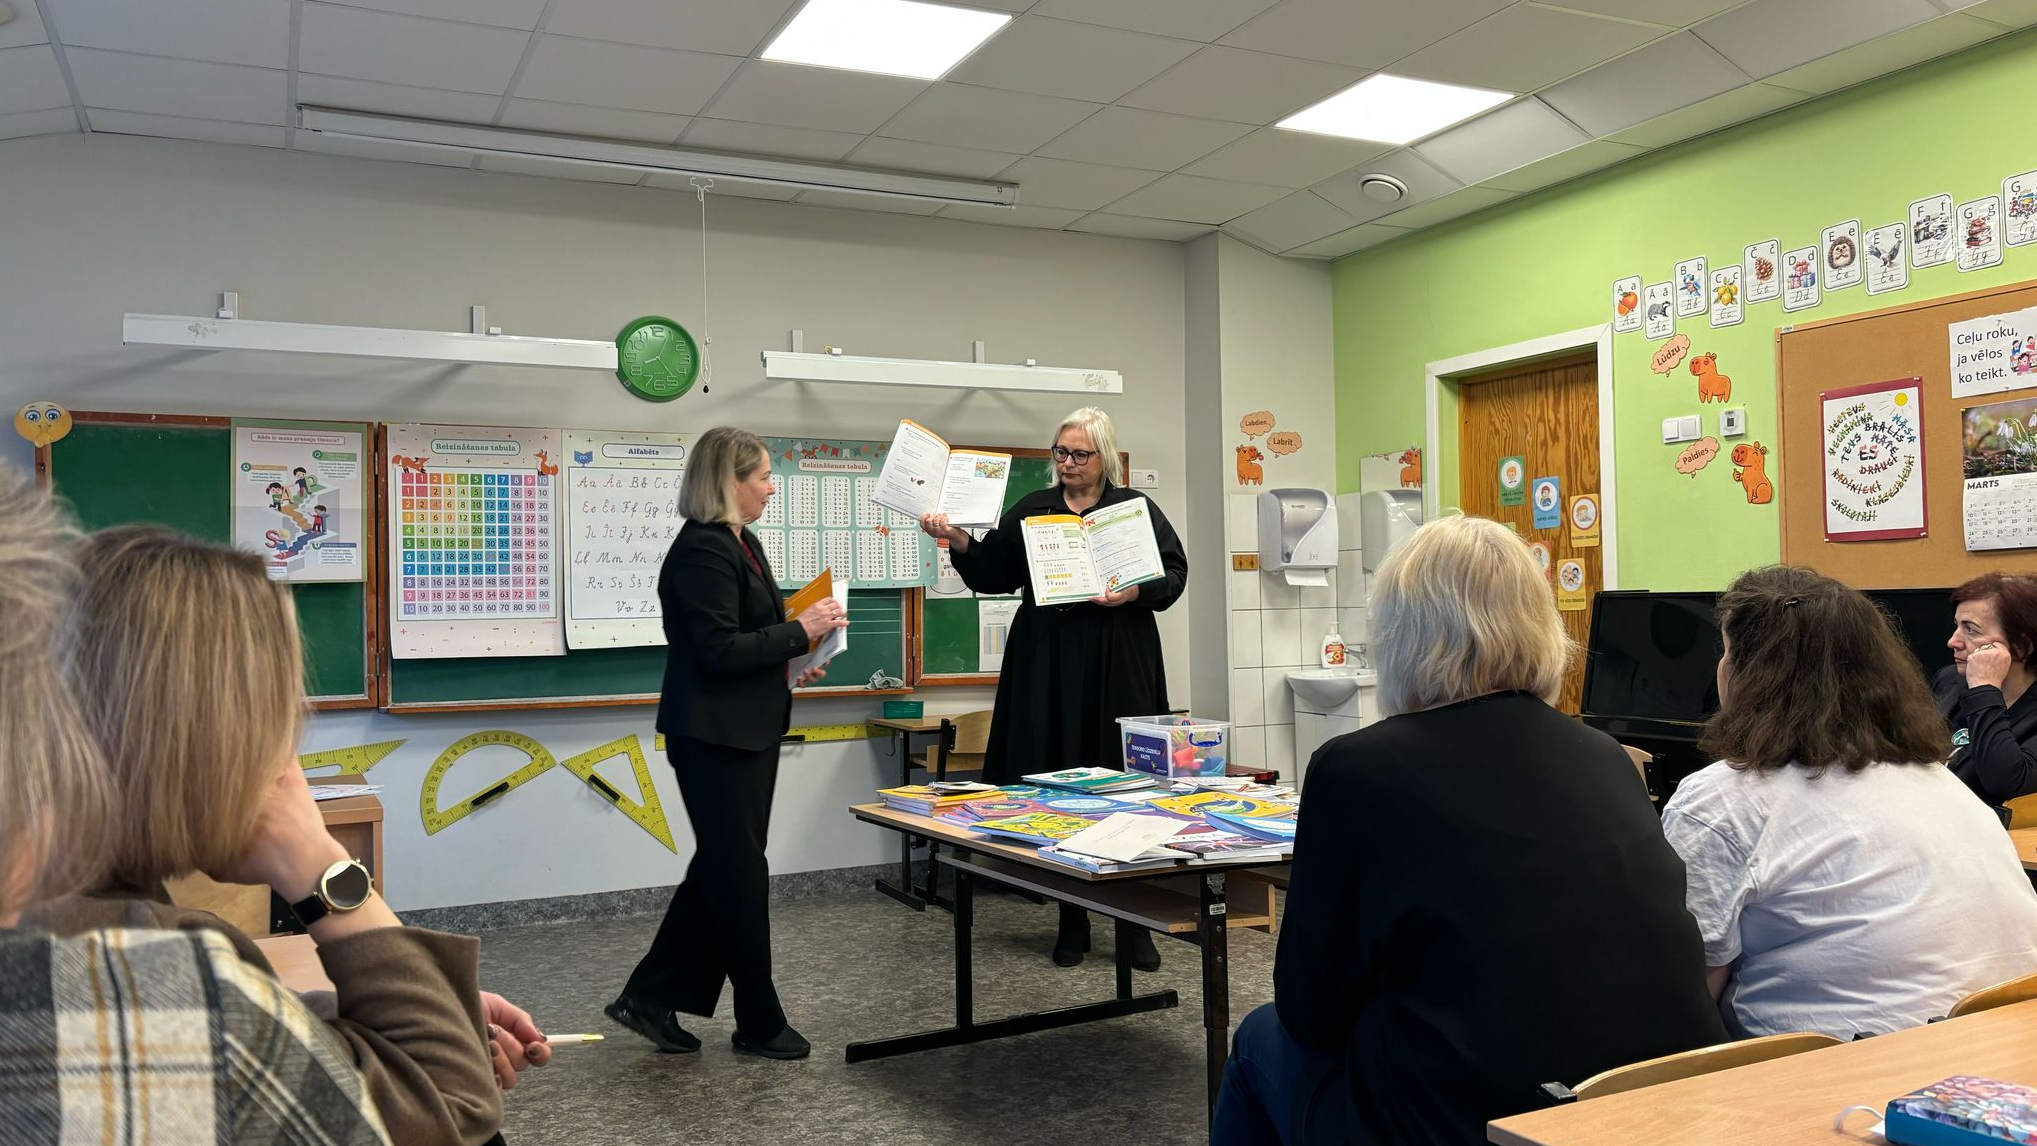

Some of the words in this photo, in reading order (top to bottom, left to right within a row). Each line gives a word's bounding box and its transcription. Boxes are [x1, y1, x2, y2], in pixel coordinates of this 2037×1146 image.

[1917, 206, 1924, 217] F
[1940, 200, 1945, 211] f
[1964, 207, 1973, 219] G
[1988, 204, 1996, 216] g
[1829, 231, 1835, 242] E
[1849, 228, 1855, 236] e
[1894, 229, 1901, 239] ē
[1750, 246, 1757, 259] Č
[1769, 243, 1775, 254] č
[1788, 255, 1797, 266] D
[1808, 250, 1814, 261] d
[1680, 265, 1687, 275] B
[1697, 261, 1703, 271] b
[1715, 273, 1722, 283] C
[1733, 272, 1738, 280] c
[1617, 285, 1623, 294] A
[1631, 283, 1636, 291] a
[1649, 289, 1656, 299] Ā
[1662, 288, 1668, 297] ā
[638, 331, 648, 340] 11
[650, 326, 664, 337] 12
[1957, 331, 1982, 345] Ceļu
[1986, 326, 2018, 340] roku,
[629, 340, 646, 350] 10
[675, 340, 686, 351] 2
[625, 352, 636, 363] 9
[680, 354, 691, 365] 3
[1656, 345, 1681, 366] Lūdzu
[1956, 353, 1967, 367] ja
[1970, 349, 2003, 362] vēlos
[631, 365, 642, 376] 8
[1958, 373, 1972, 384] ko
[1976, 367, 2007, 381] teikt.
[643, 374, 654, 387] 7
[654, 379, 665, 391] 6
[666, 376, 678, 387] 5
[490, 444, 516, 452] tabula
[628, 448, 660, 456] Alfabēts
[1682, 447, 1709, 465] Paldies
[420, 474, 424, 482] 1
[460, 475, 466, 483] 4
[473, 475, 479, 483] 5
[487, 475, 493, 483] 6
[500, 476, 506, 484] 7
[514, 476, 519, 484] 8
[527, 476, 532, 484] 9
[654, 477, 668, 489] Cc
[1967, 479, 1999, 490] MARTS
[420, 514, 425, 522] 3
[433, 514, 439, 522] 6
[459, 514, 468, 522] 12
[472, 514, 481, 522] 15
[486, 514, 495, 522] 18
[499, 514, 508, 522] 21
[512, 514, 522, 522] 24
[525, 514, 535, 522] 27
[596, 551, 623, 564] Mm
[629, 551, 647, 564] Nn
[405, 604, 415, 612] 10
[418, 604, 428, 612] 10
[433, 604, 442, 612] 20
[447, 604, 456, 612] 30
[487, 603, 496, 611] 60
[500, 603, 510, 611] 70
[513, 603, 523, 611] 80
[526, 603, 536, 611] 90
